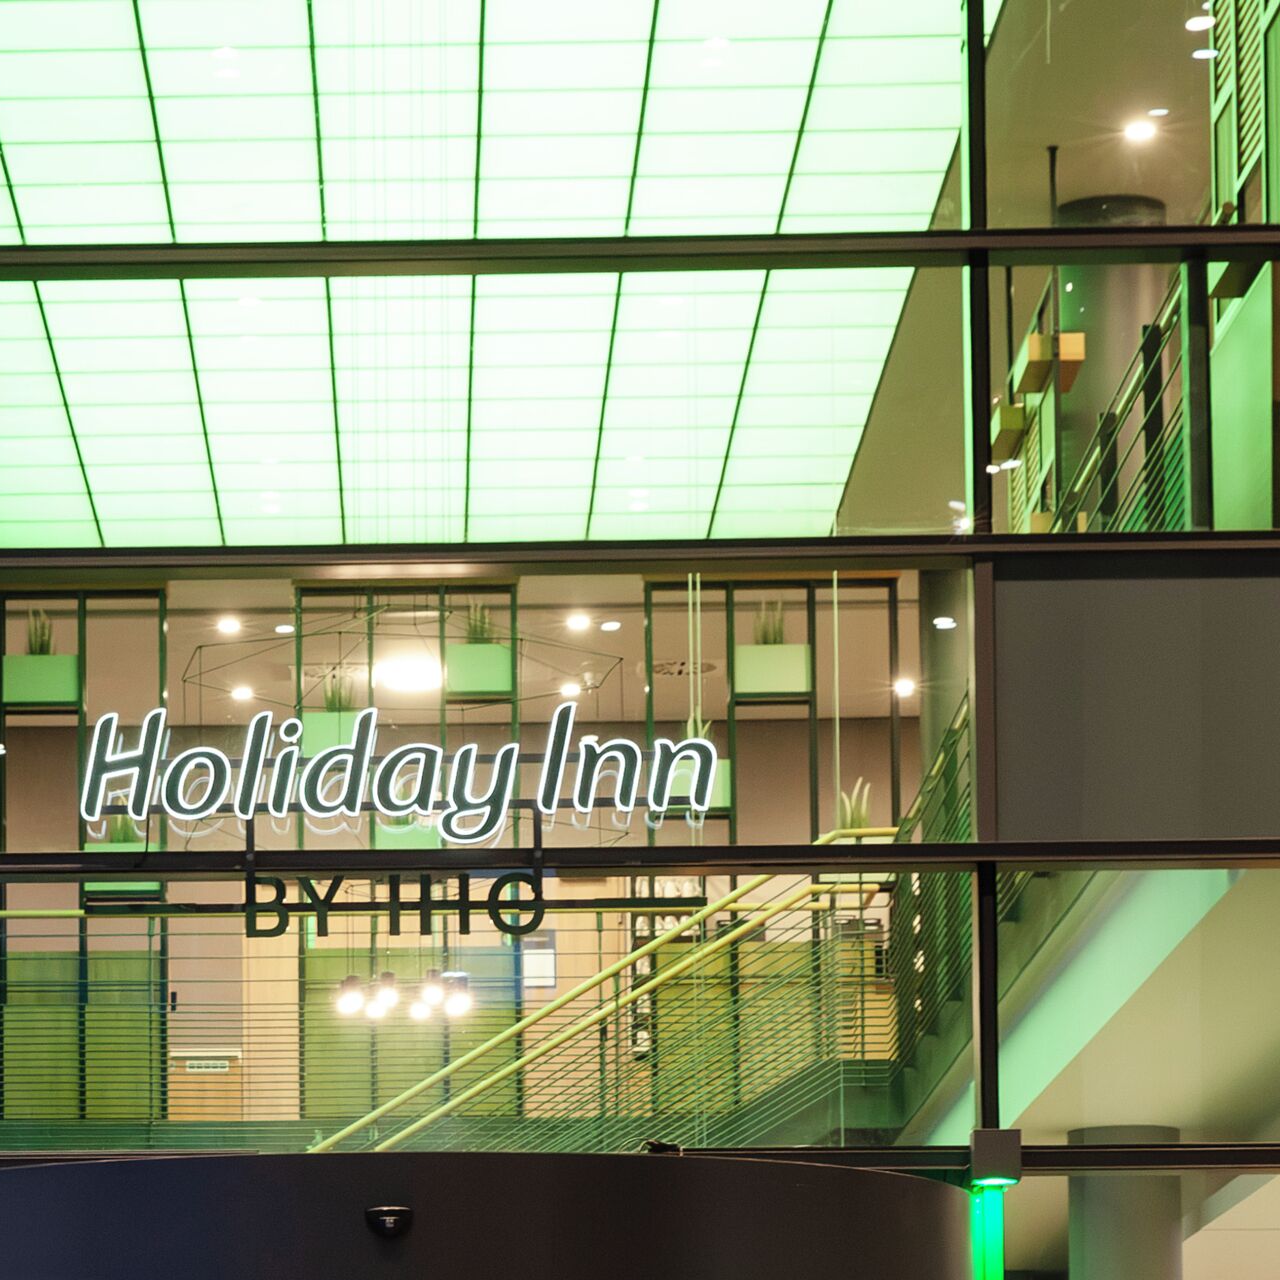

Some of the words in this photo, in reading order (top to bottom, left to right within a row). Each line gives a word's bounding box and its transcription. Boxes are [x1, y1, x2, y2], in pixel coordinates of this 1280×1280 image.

[79, 706, 520, 845] Holiday
[536, 701, 718, 816] Inn
[245, 873, 346, 939] BY
[387, 871, 545, 937] IHG
